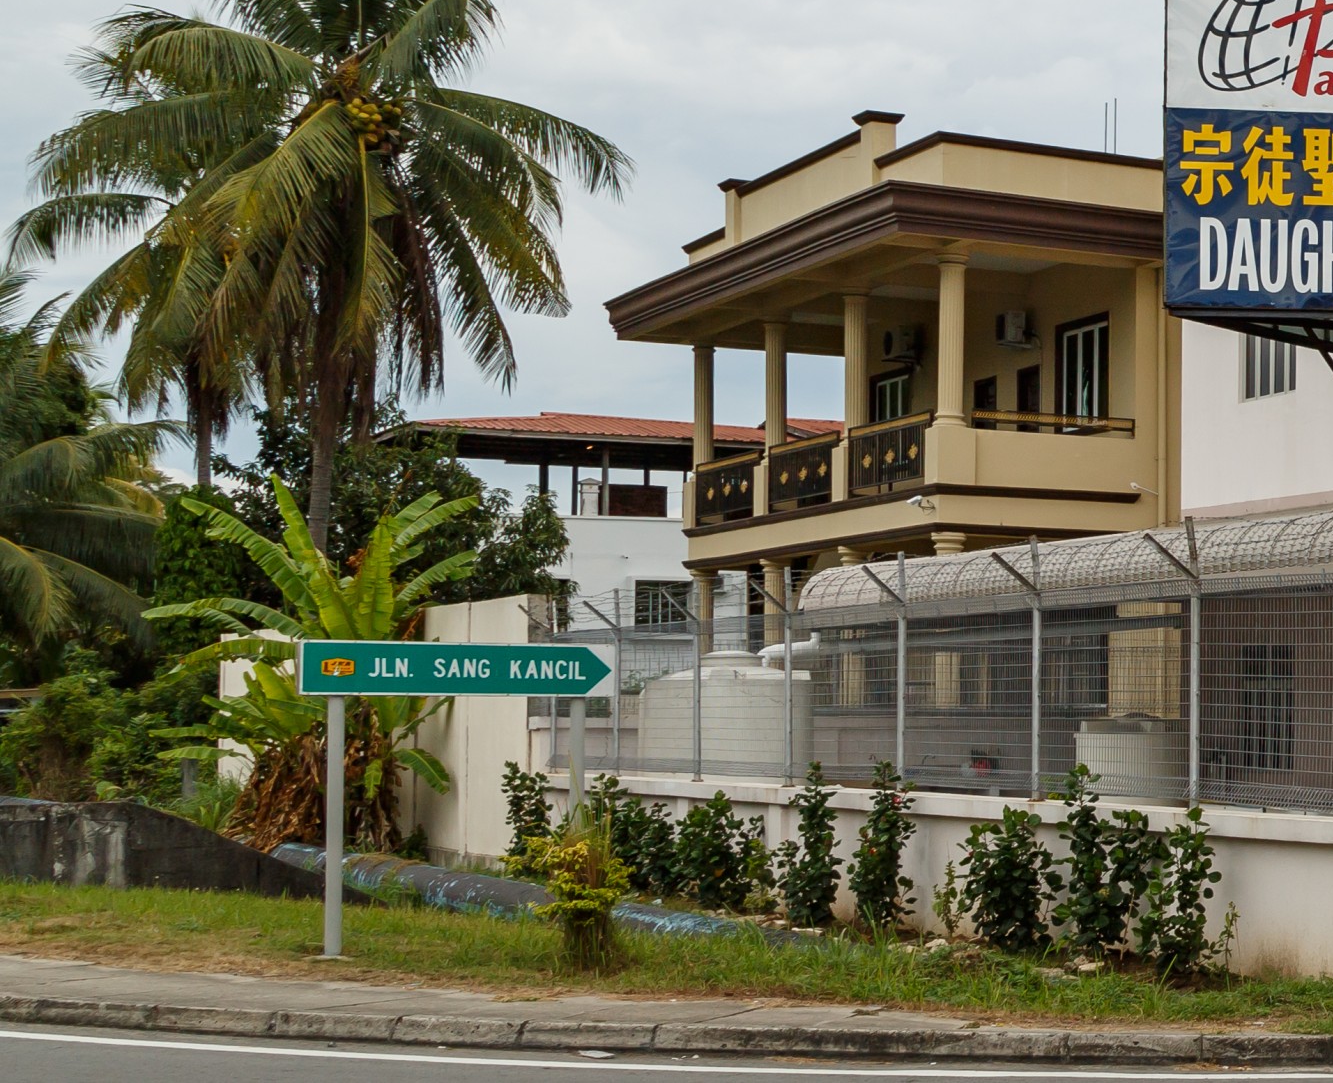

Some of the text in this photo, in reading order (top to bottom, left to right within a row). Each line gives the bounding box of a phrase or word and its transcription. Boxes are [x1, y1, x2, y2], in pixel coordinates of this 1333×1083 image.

[368, 657, 586, 680] JLN. SANG KANCIL
